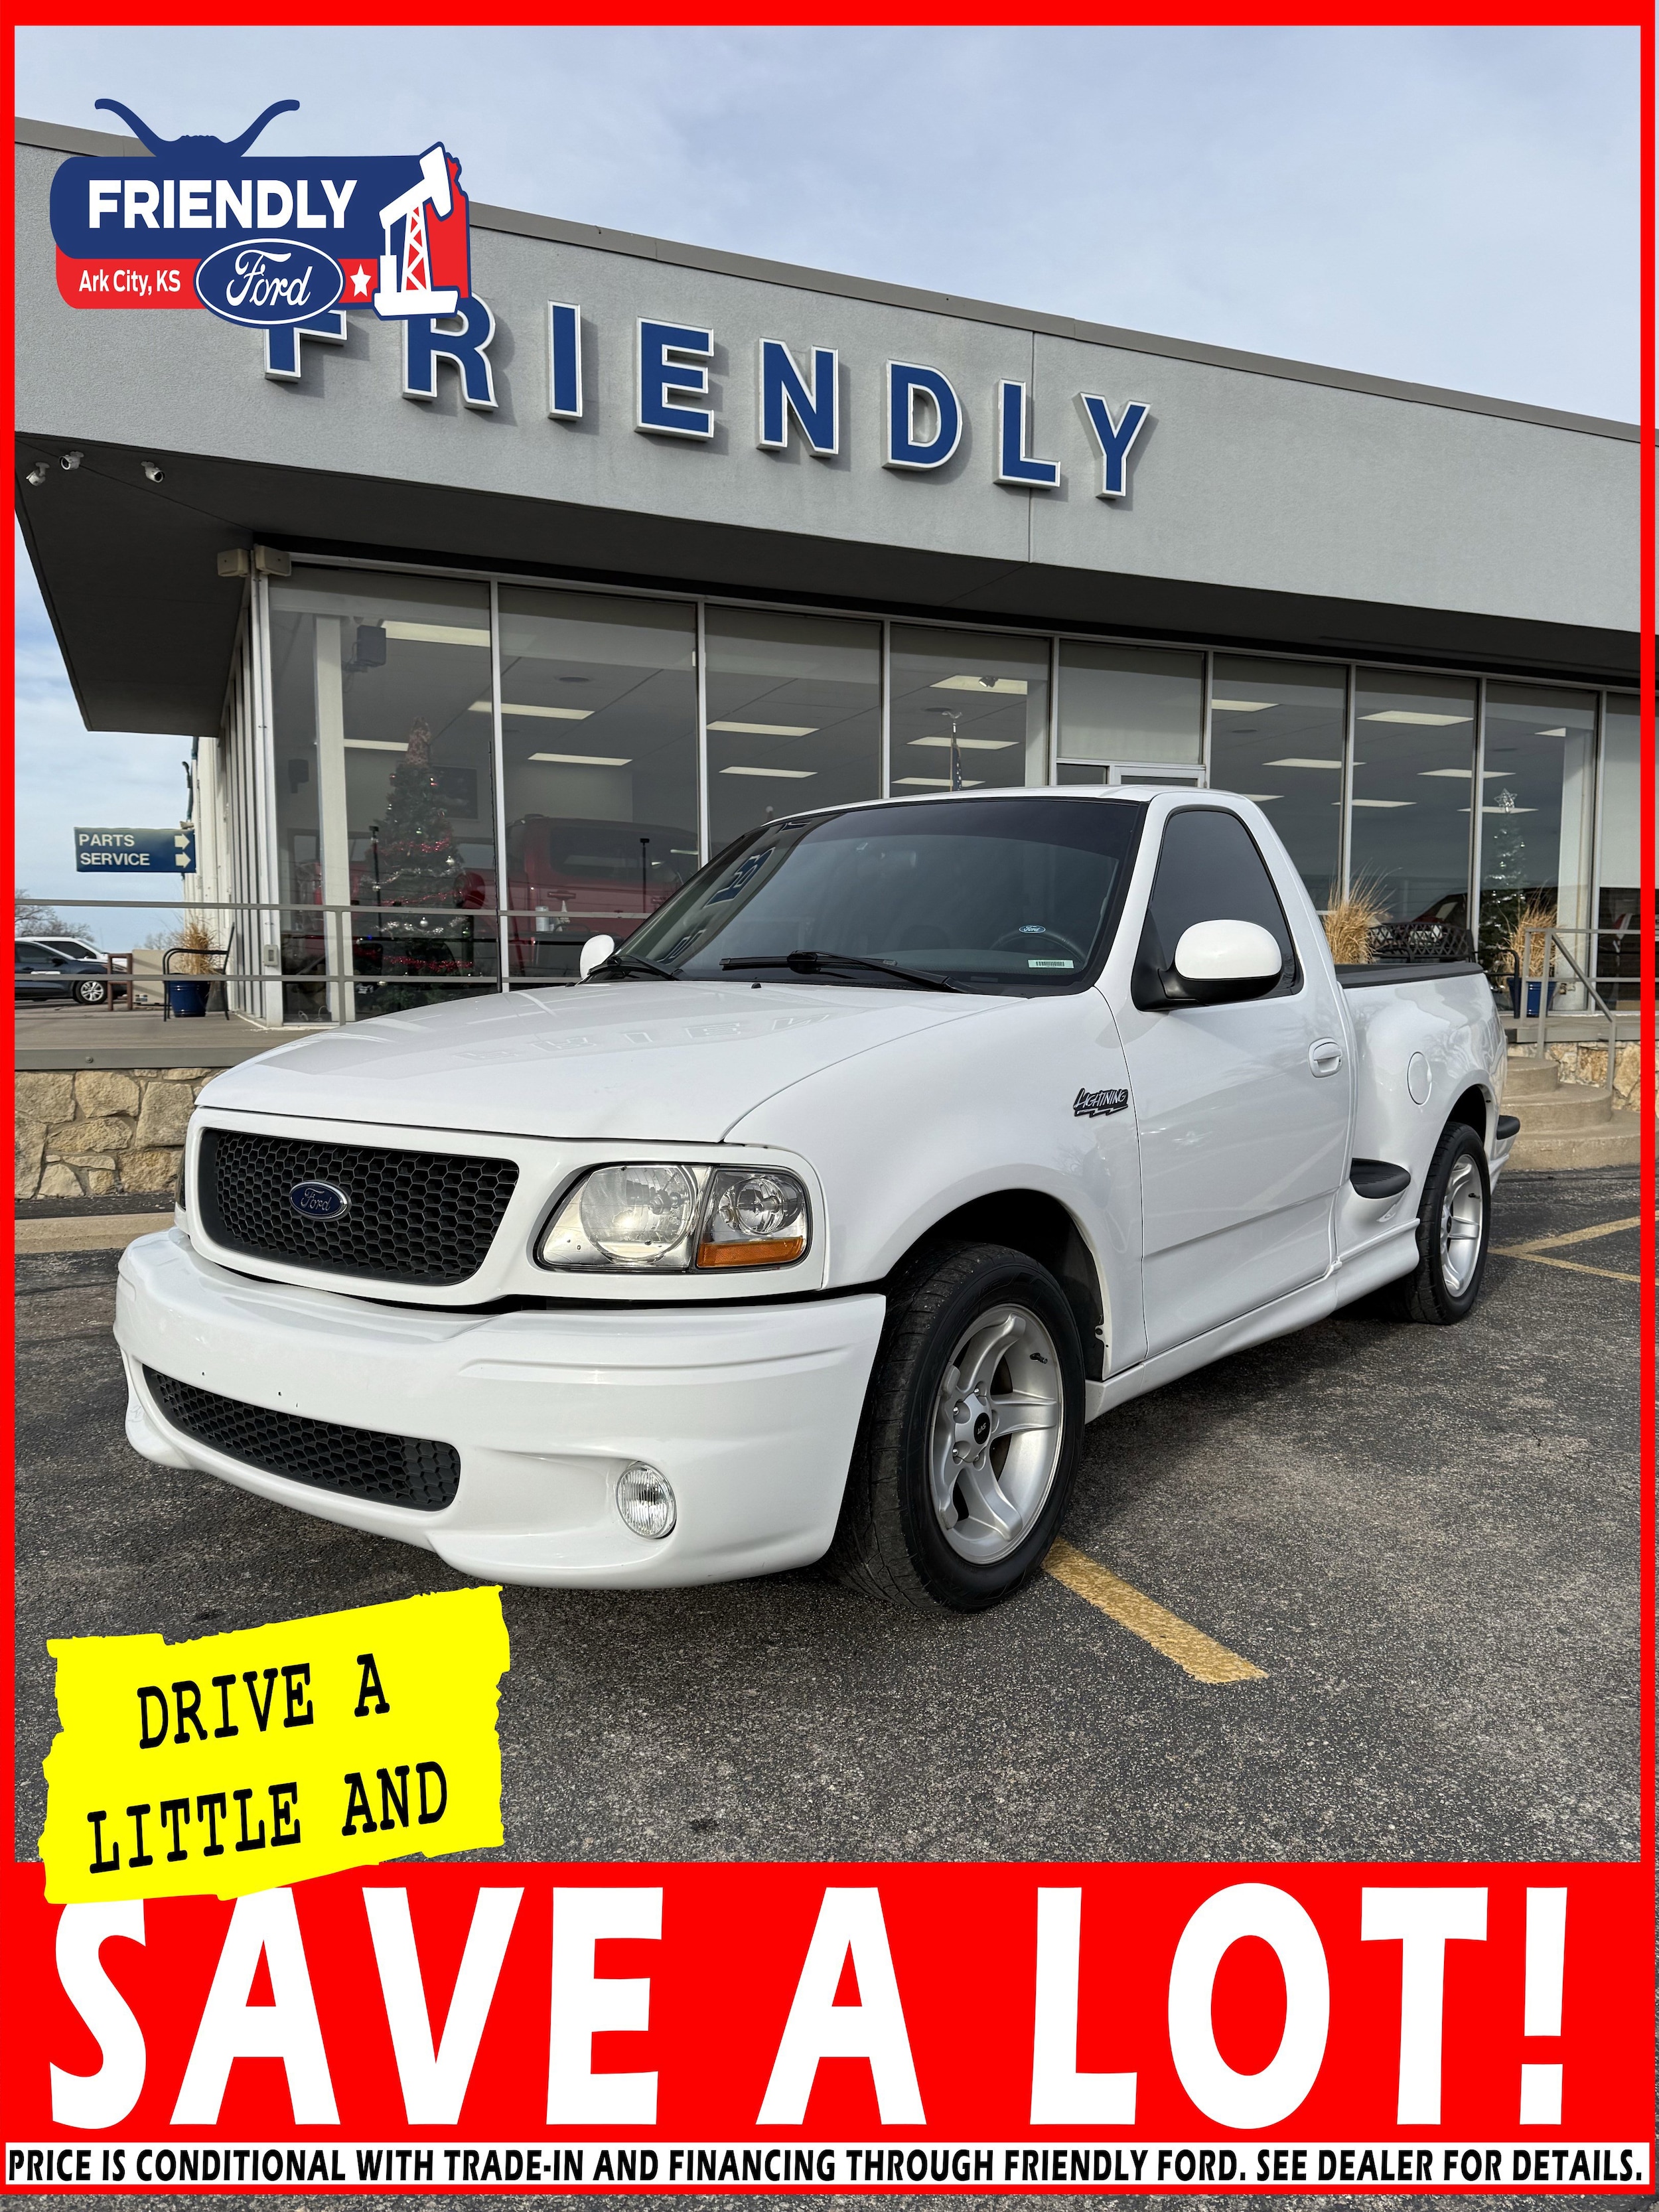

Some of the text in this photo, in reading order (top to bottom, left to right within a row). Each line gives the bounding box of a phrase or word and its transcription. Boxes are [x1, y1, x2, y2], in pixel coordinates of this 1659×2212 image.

[78, 834, 135, 847] PARTS
[80, 852, 151, 866] SERVICE
[1074, 1088, 1127, 1108] LIGHTNING
